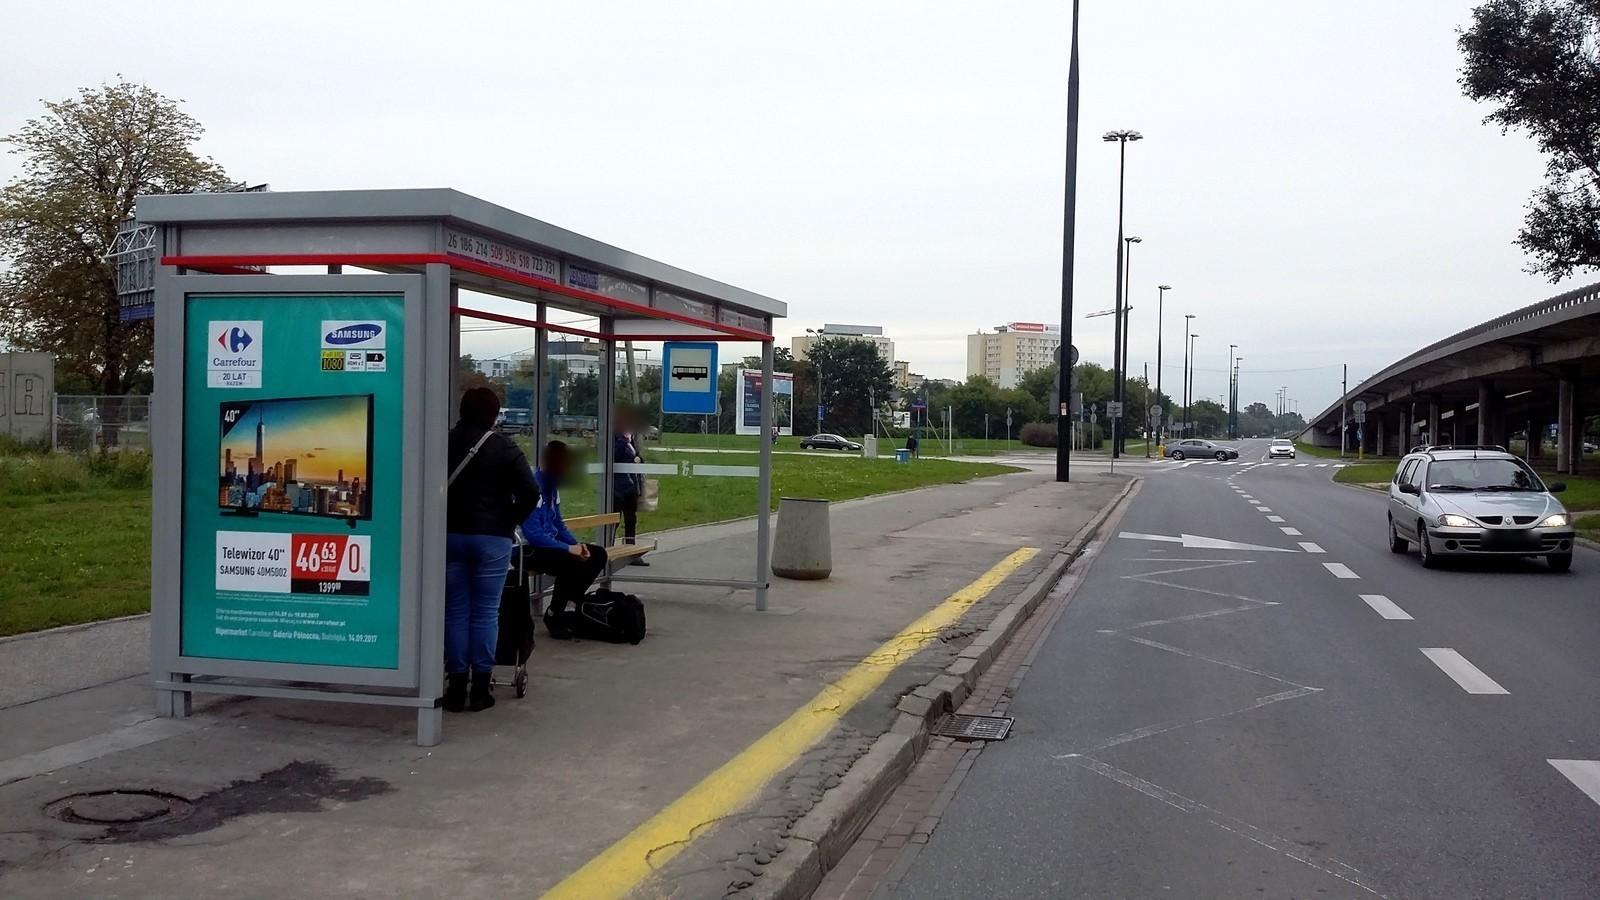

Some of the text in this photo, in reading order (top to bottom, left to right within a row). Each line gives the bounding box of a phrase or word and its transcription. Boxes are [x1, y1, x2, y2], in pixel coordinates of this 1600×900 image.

[447, 233, 457, 249] 26
[460, 237, 473, 252] 186
[475, 241, 488, 257] 214
[491, 245, 503, 261] 509
[506, 249, 516, 265] 516
[519, 254, 529, 269] 518
[532, 256, 543, 272] 723
[545, 260, 555, 275] 731
[331, 330, 375, 338] SAMSUNG
[213, 357, 256, 367] Carrefour
[322, 358, 343, 370] 1080
[222, 372, 247, 381] 20 LAT
[222, 546, 266, 561] Telewizor
[220, 565, 287, 578] SAMSUNG 40M5002
[319, 582, 336, 593] 1399
[348, 633, 378, 643] 14.09.2017
